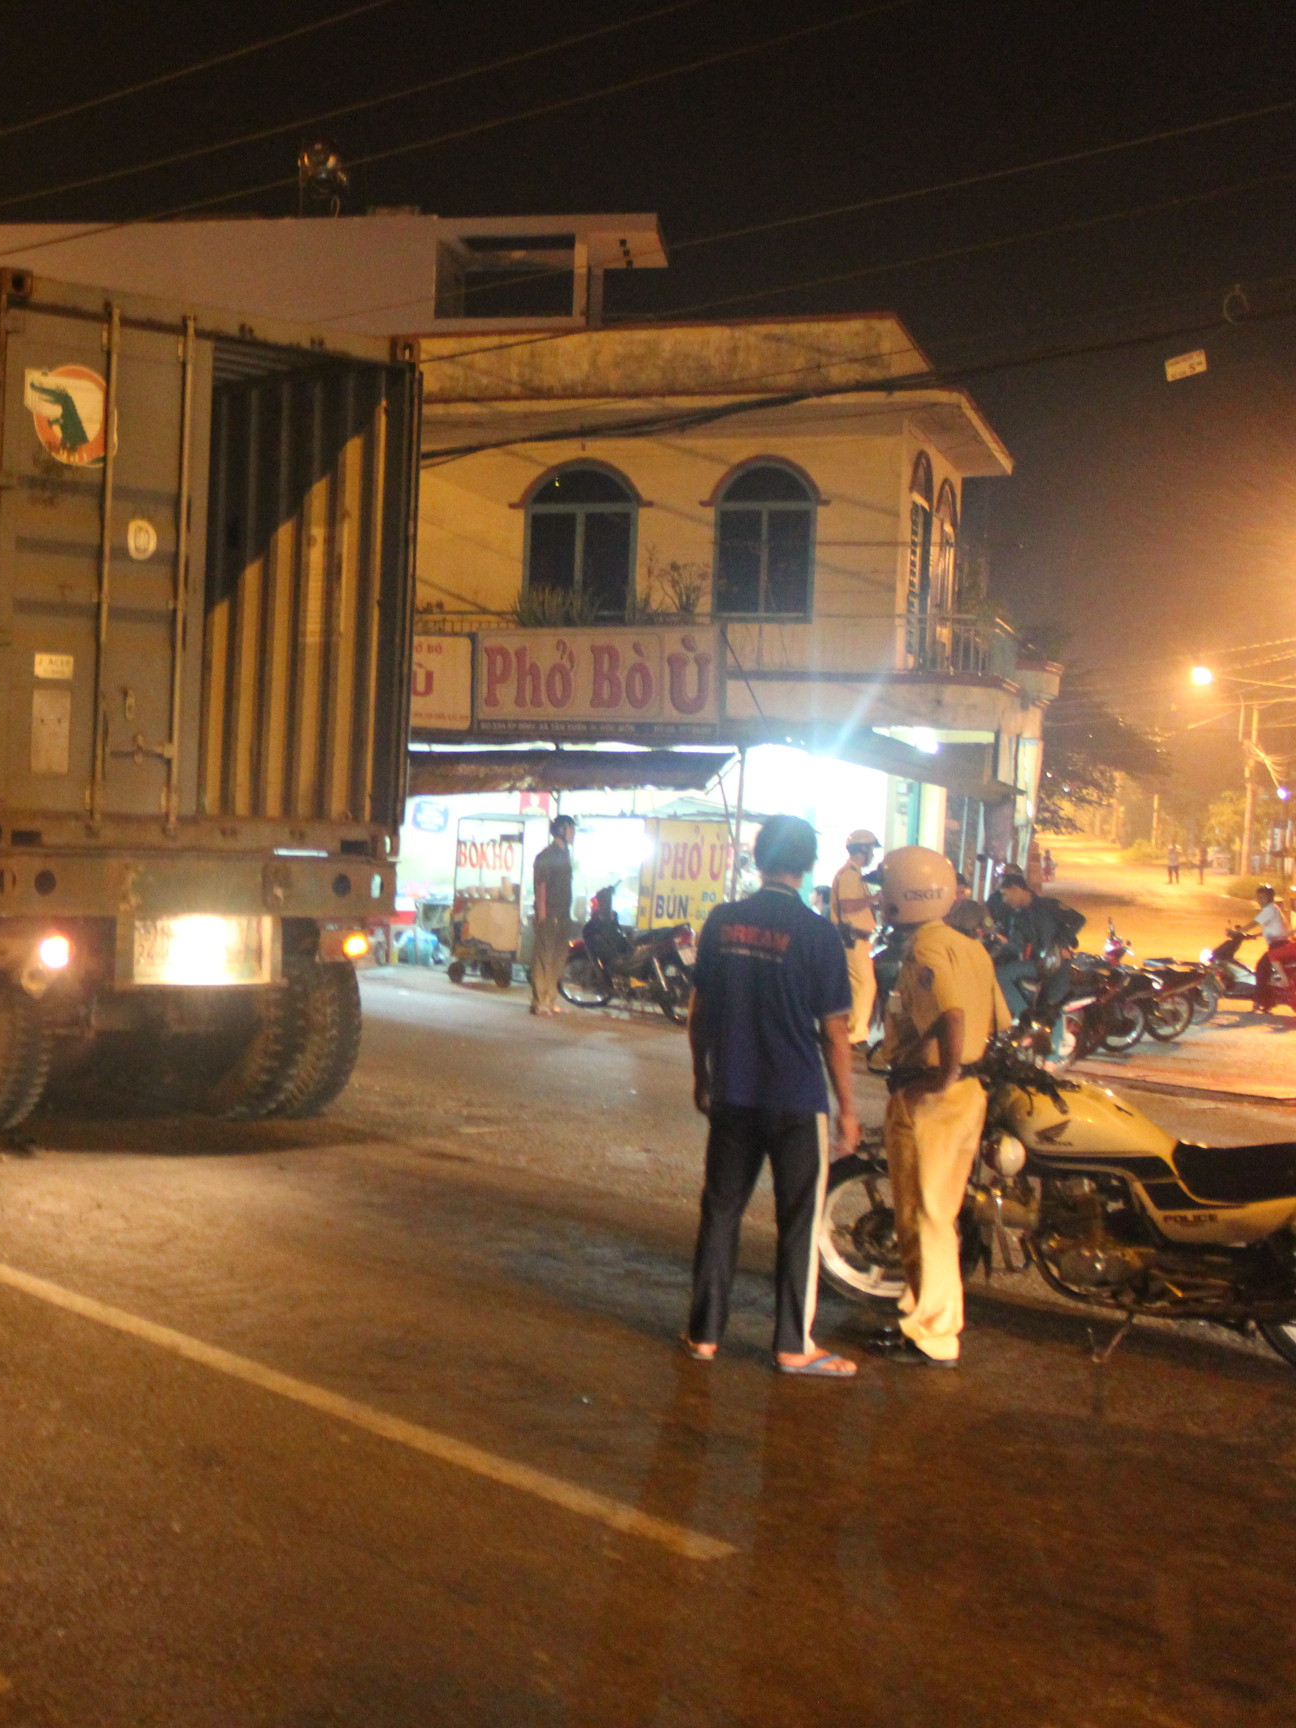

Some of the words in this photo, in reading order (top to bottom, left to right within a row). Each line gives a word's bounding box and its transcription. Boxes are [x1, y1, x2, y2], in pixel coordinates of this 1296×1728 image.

[484, 638, 575, 708] Phở
[590, 641, 653, 709] Bò
[667, 634, 712, 715] Ù
[1163, 1213, 1219, 1227] POLICE
